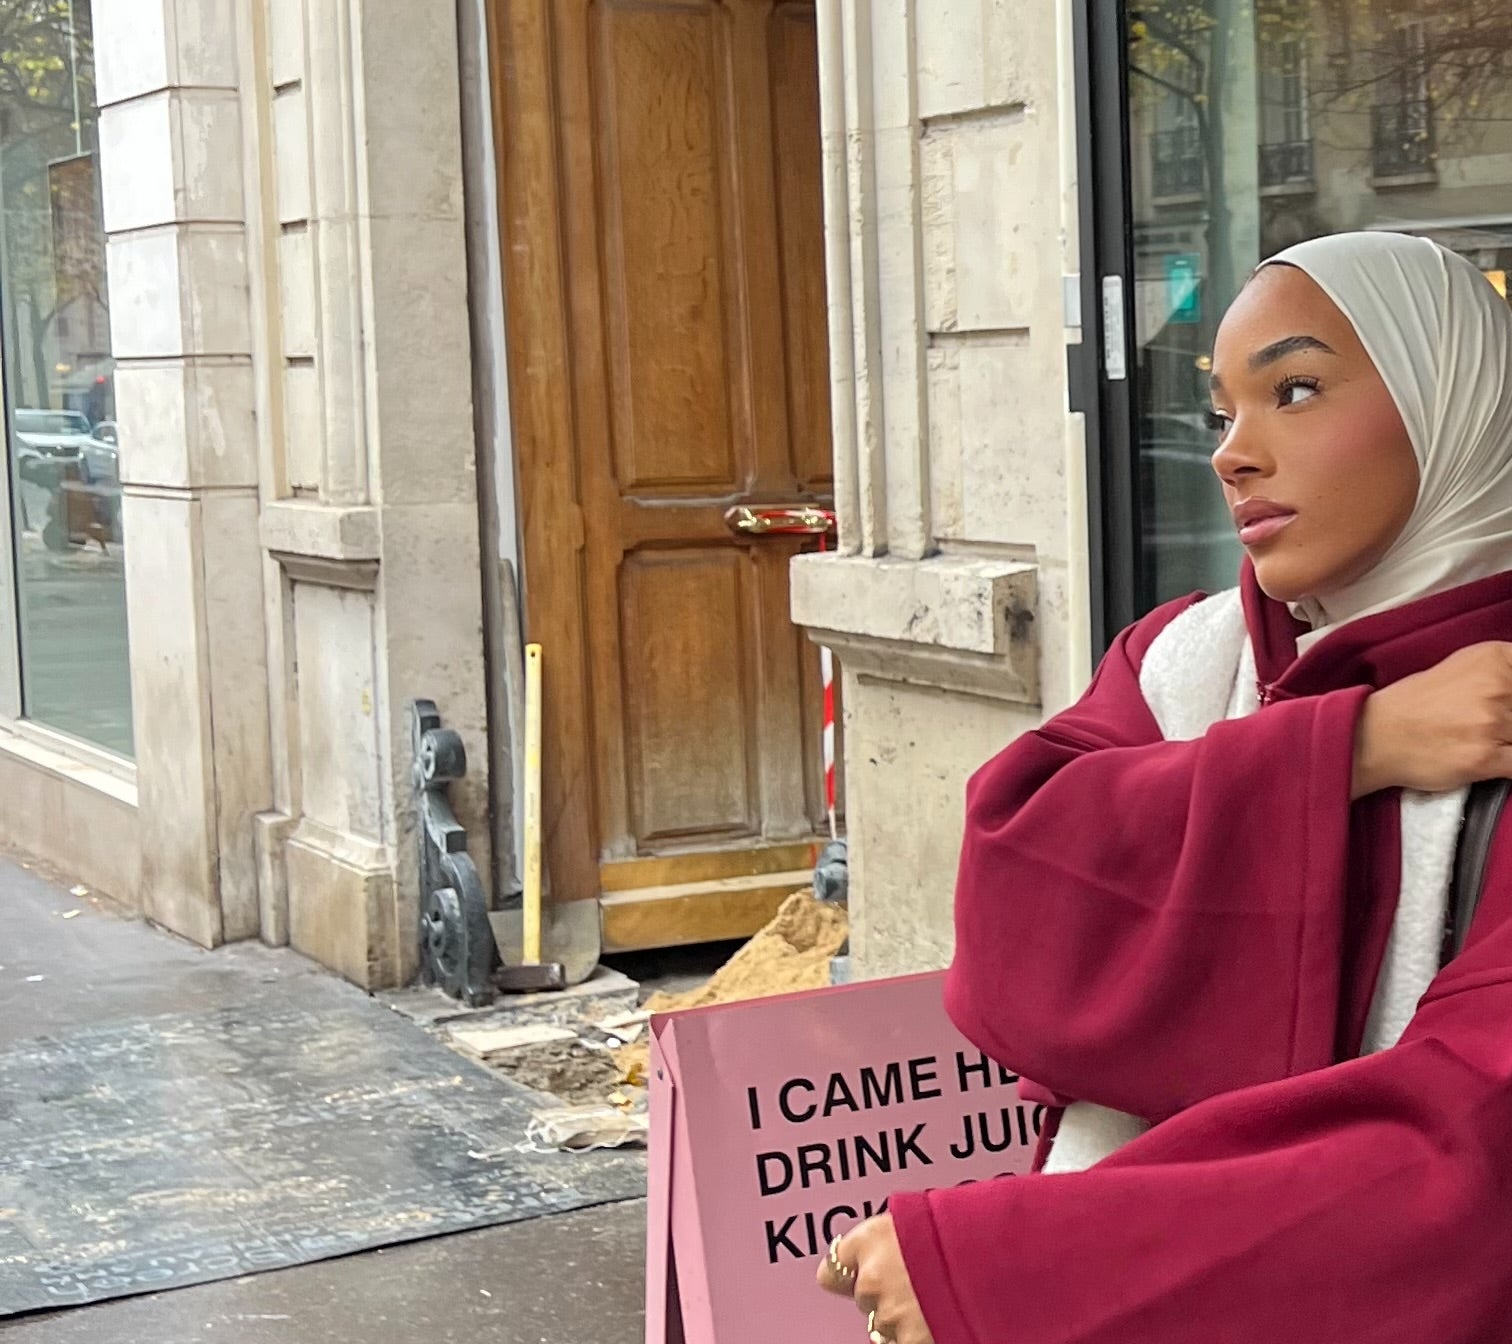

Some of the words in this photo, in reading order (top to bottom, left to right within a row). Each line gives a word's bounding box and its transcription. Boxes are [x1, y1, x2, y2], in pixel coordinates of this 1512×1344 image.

[747, 1086, 762, 1130] I
[778, 1055, 943, 1124] CAME
[756, 1122, 934, 1197] DRINK
